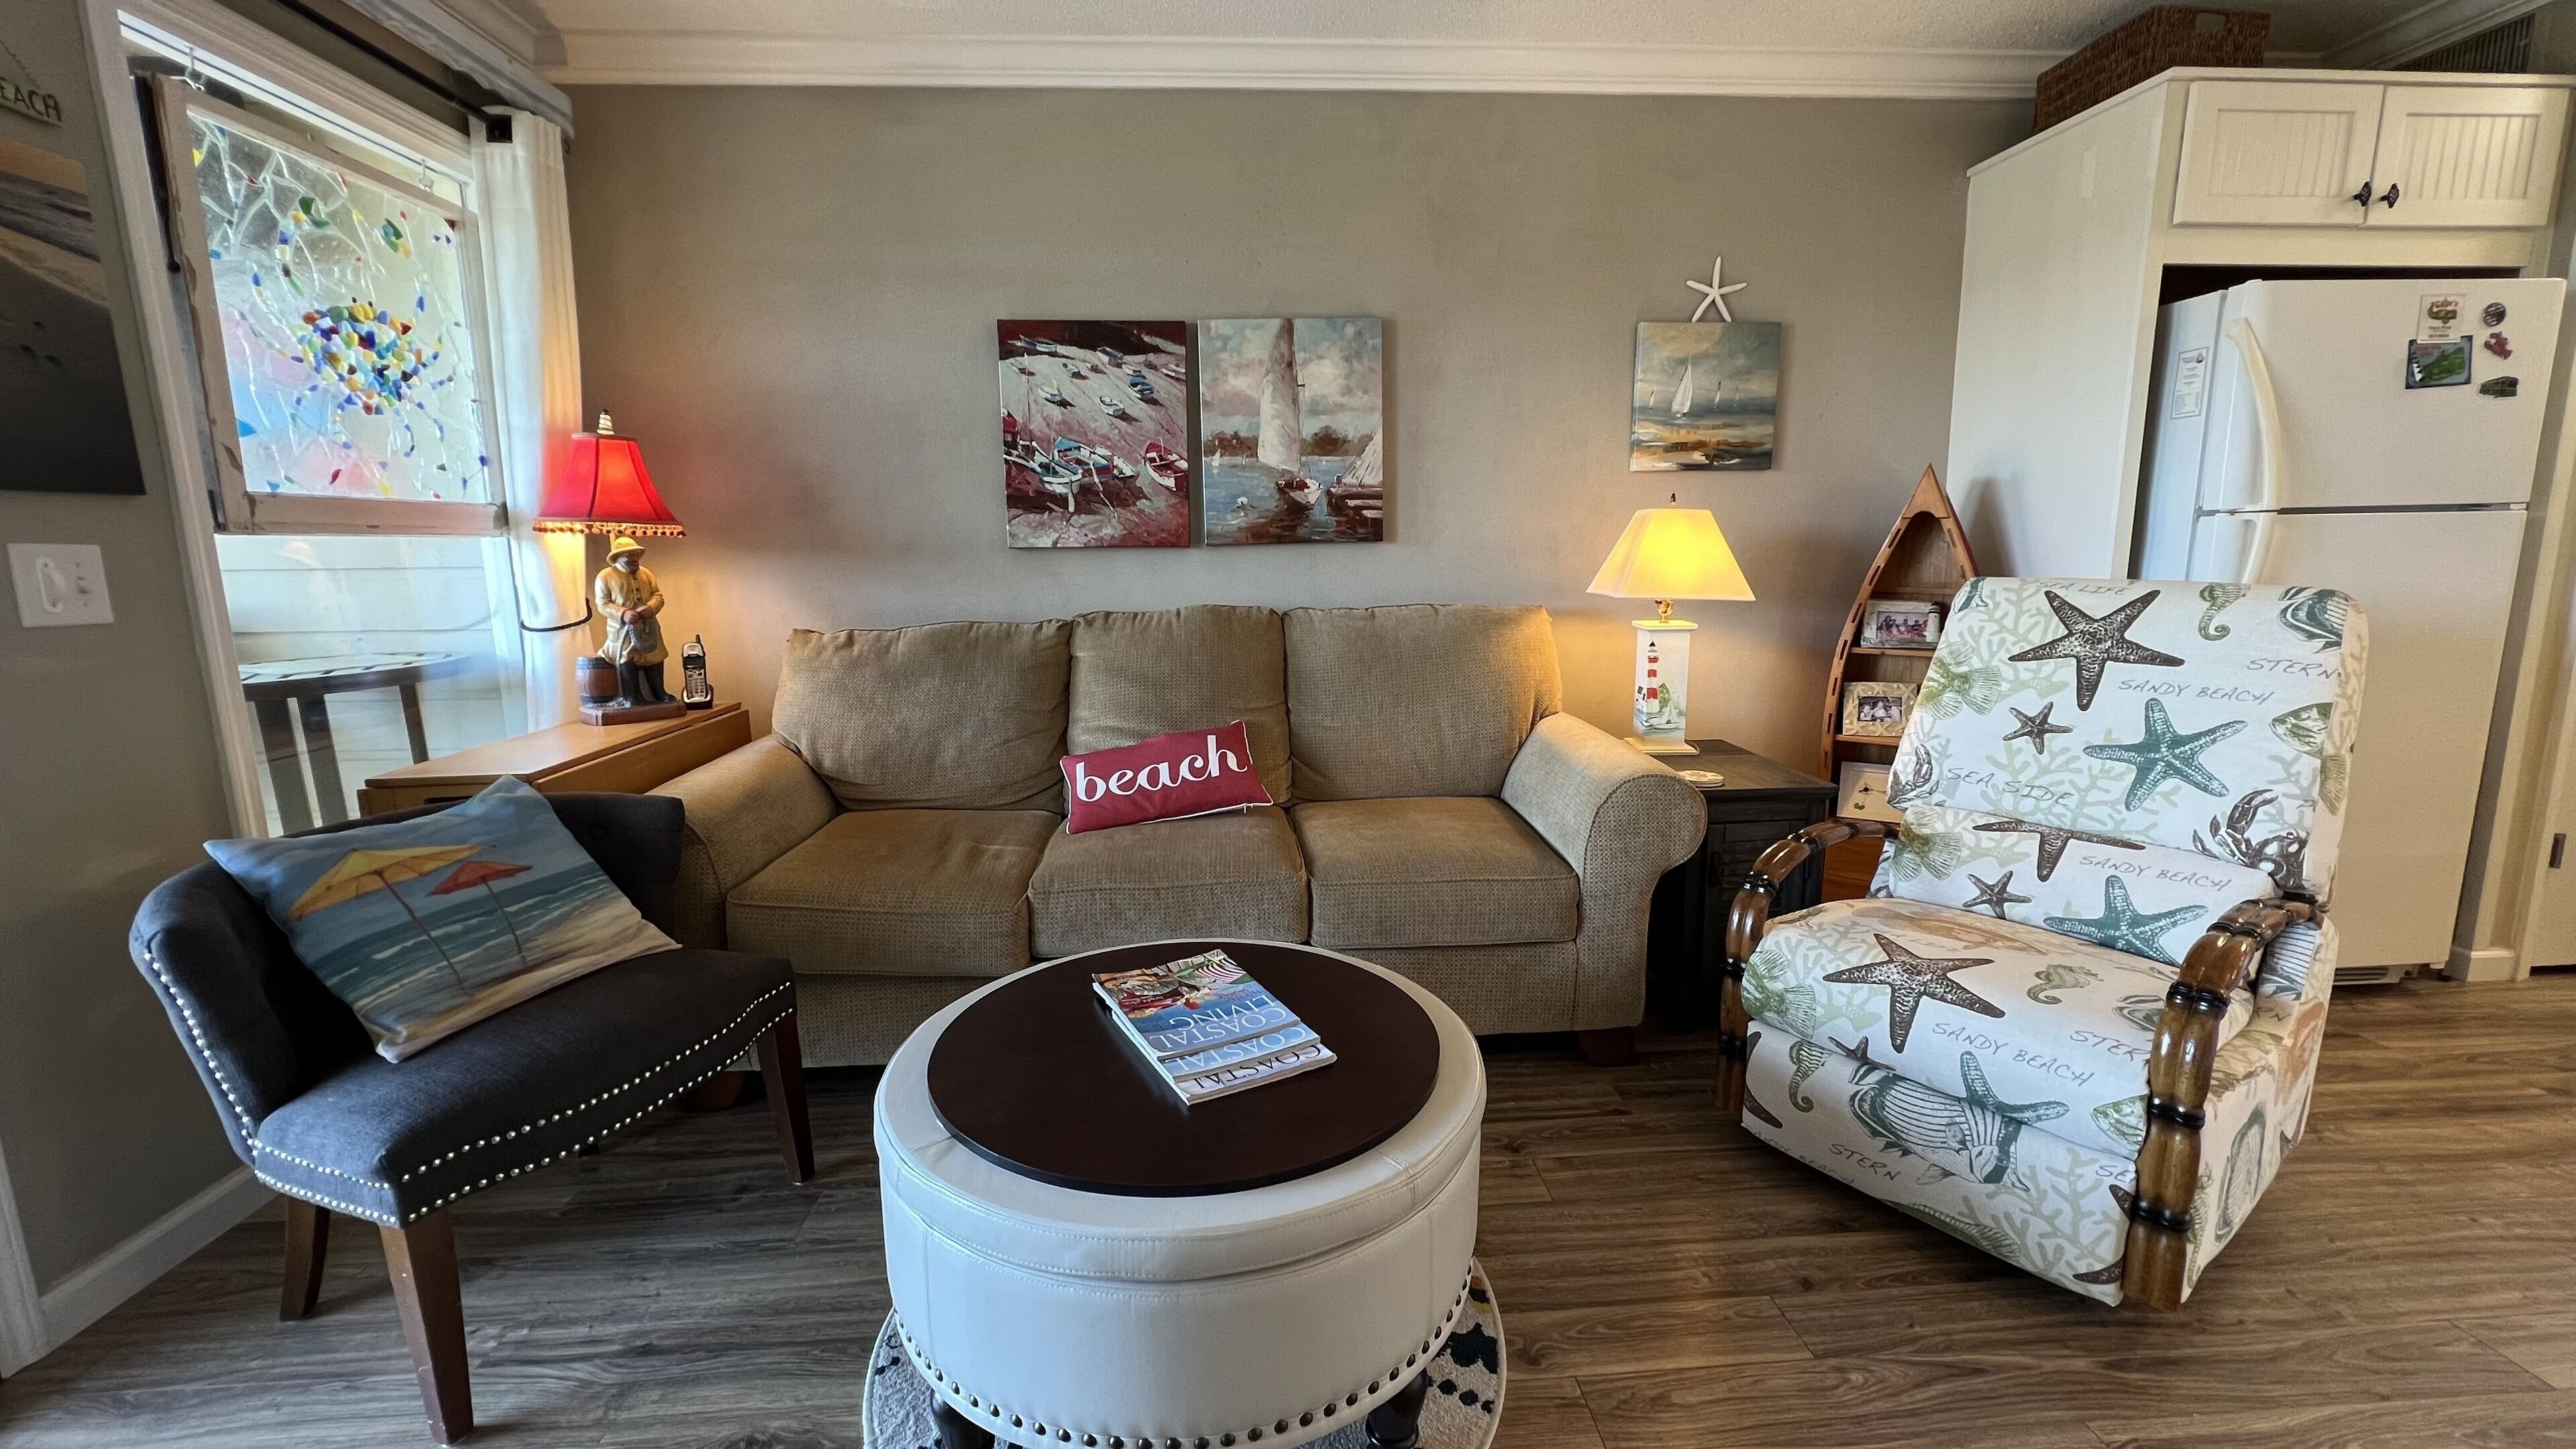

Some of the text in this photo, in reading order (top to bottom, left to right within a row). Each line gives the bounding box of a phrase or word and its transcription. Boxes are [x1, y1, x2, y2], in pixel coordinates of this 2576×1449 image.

[0, 76, 62, 121] EACH
[2078, 584, 2131, 596] LIFE
[2118, 679, 2275, 705] SANDY BEACH
[1075, 735, 1248, 802] beach
[1945, 767, 2075, 806] SEA SIDE
[2079, 855, 2233, 892] SANDY BEACH
[1150, 1008, 1287, 1048] COASTAL
[1169, 994, 1275, 1031] LIVING
[1165, 1026, 1306, 1071] COASTAL
[1933, 1022, 2095, 1086] SANDY BEACH
[2070, 1030, 2152, 1067] STER
[1829, 1142, 1902, 1181] STERN
[2096, 1165, 2136, 1184] SE
